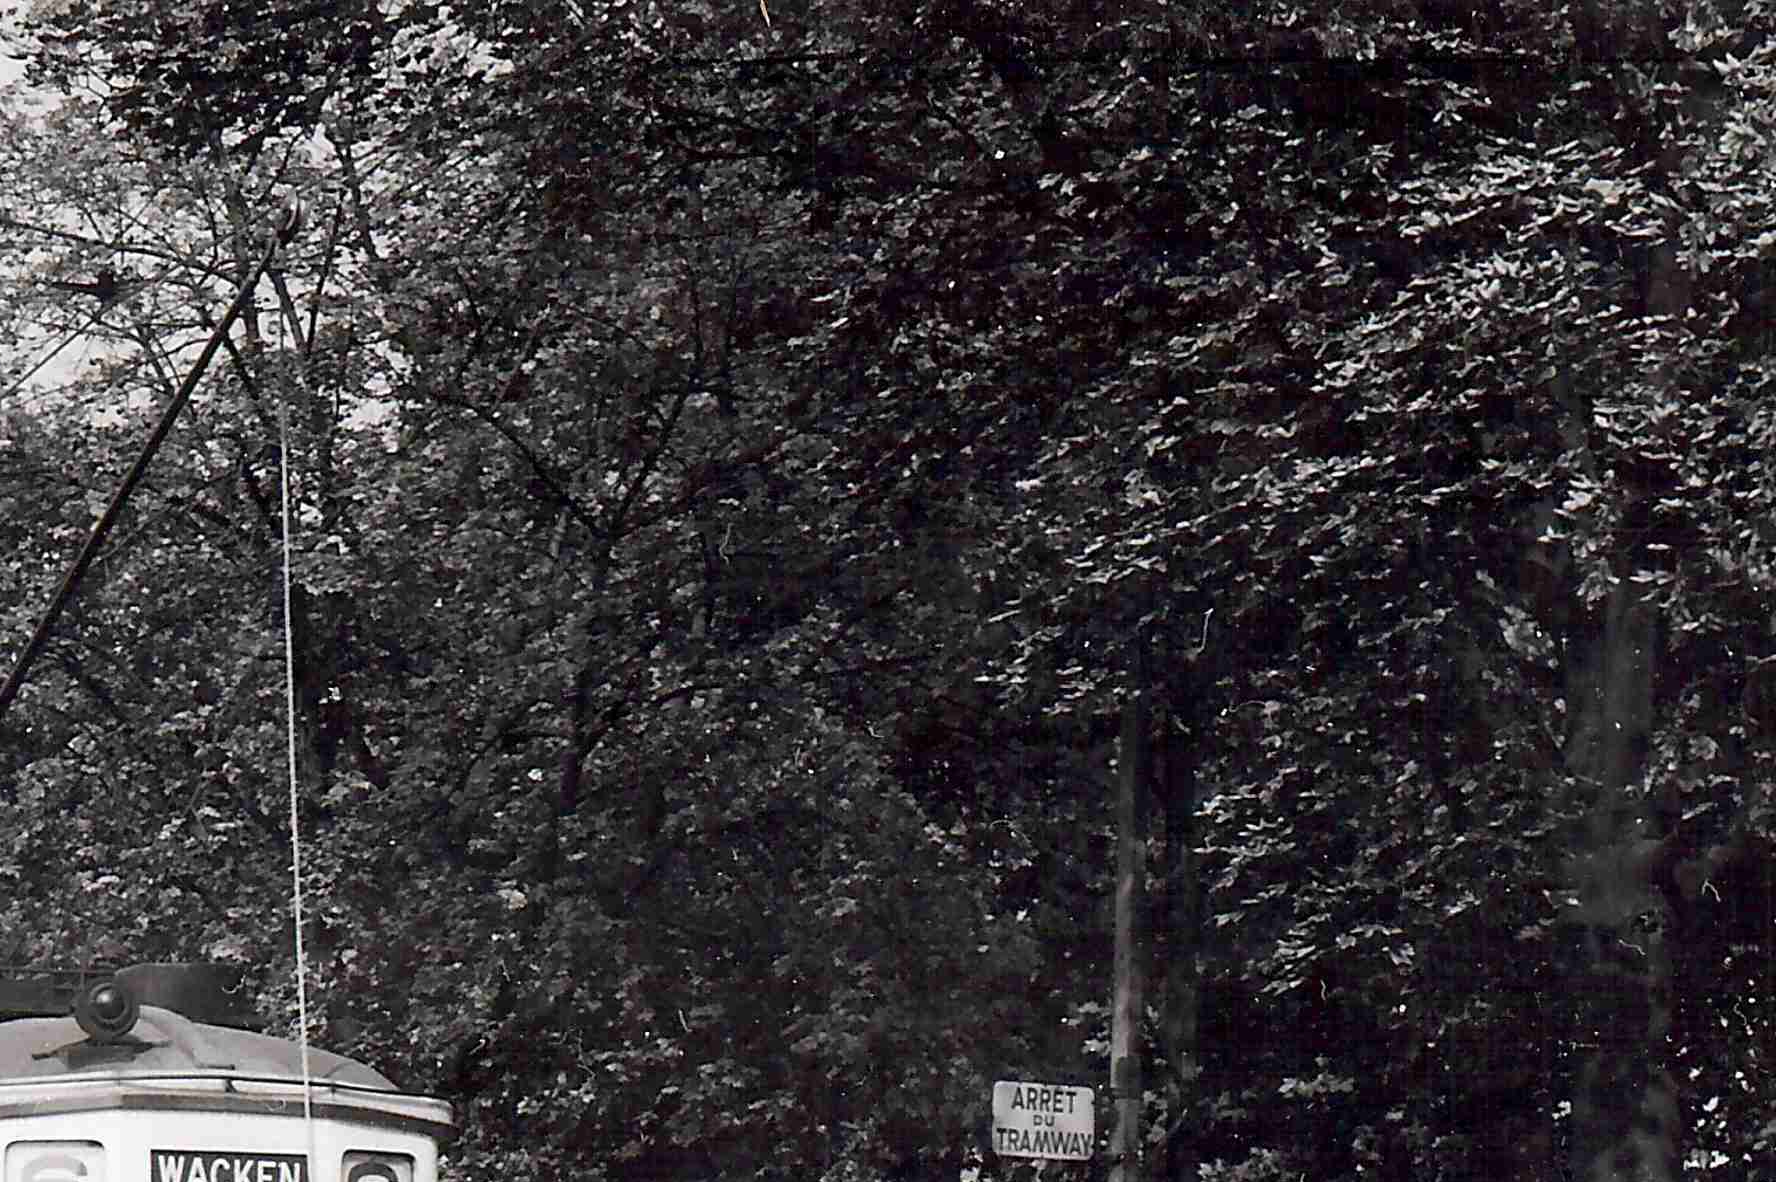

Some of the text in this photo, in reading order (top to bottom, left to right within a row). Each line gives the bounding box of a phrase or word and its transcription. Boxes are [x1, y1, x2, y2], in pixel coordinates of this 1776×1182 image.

[1011, 1086, 1077, 1114] ARRET
[1032, 1114, 1056, 1127] DU
[996, 1127, 1093, 1155] TRAMWAY
